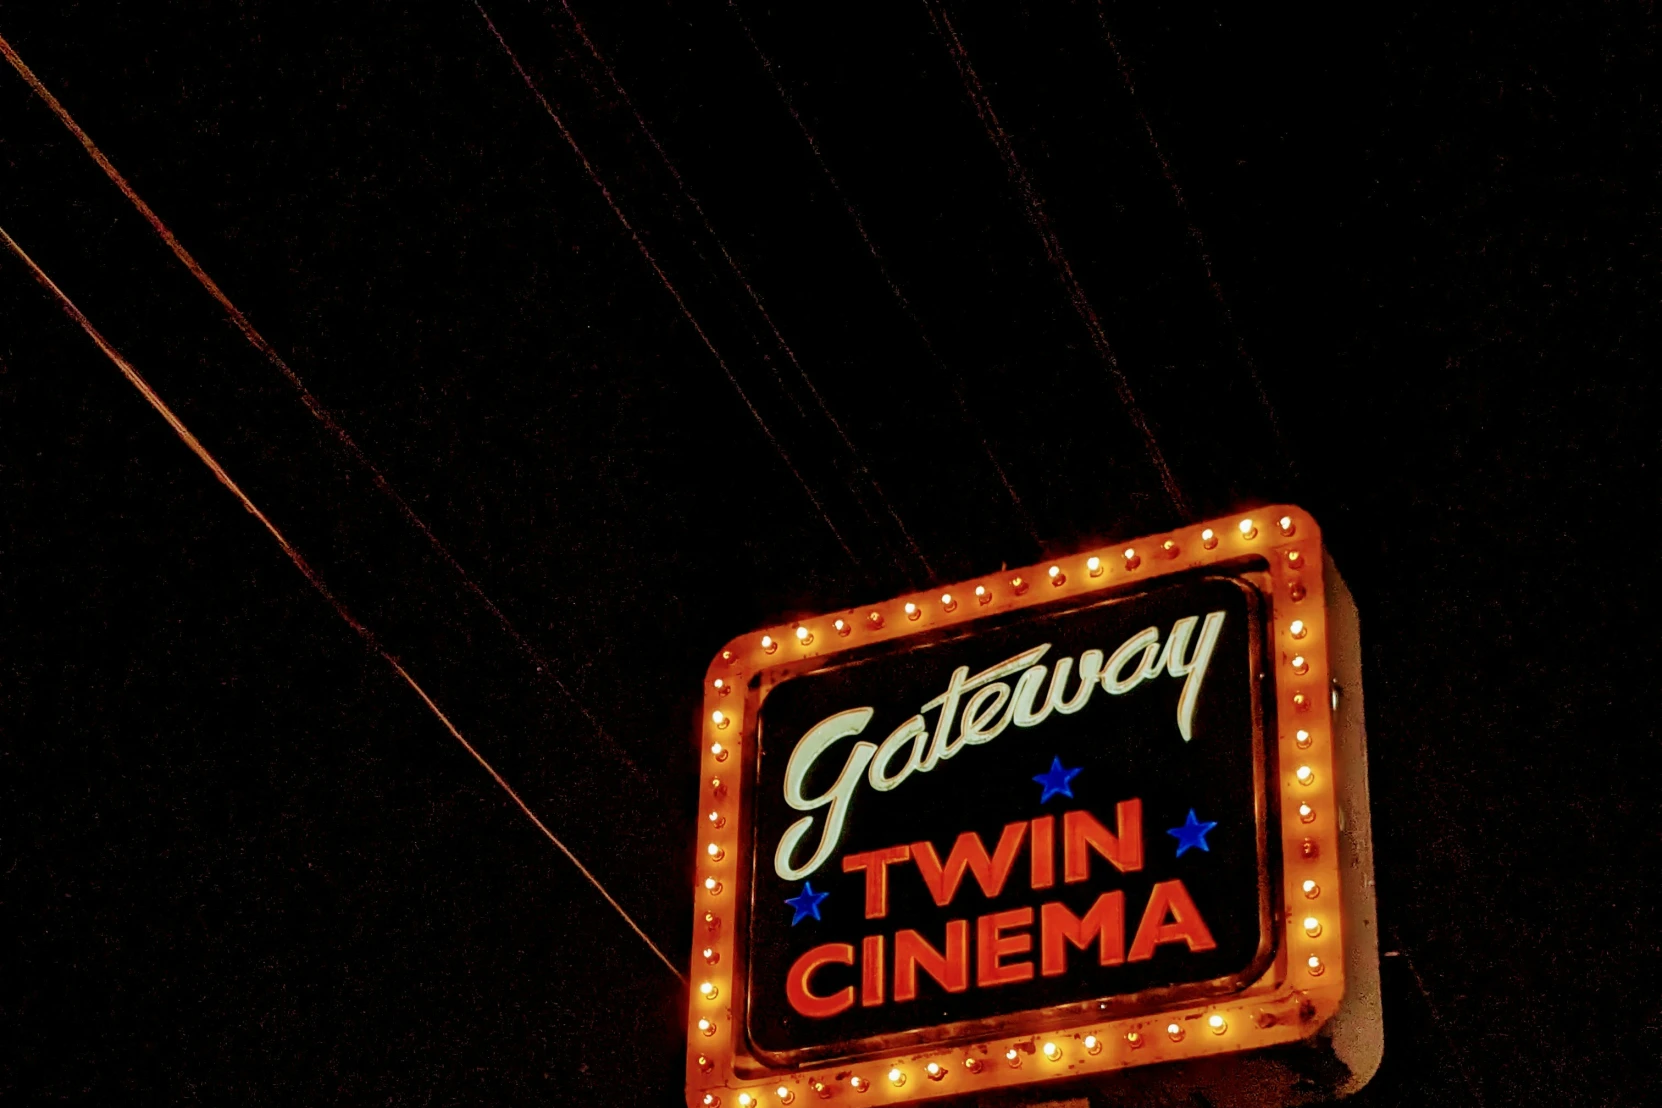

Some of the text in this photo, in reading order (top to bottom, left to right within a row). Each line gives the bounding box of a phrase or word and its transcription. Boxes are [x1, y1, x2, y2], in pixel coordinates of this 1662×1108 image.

[774, 611, 1225, 881] Gateway
[842, 797, 1143, 919] TWIN
[786, 879, 1216, 1019] CINEMA
